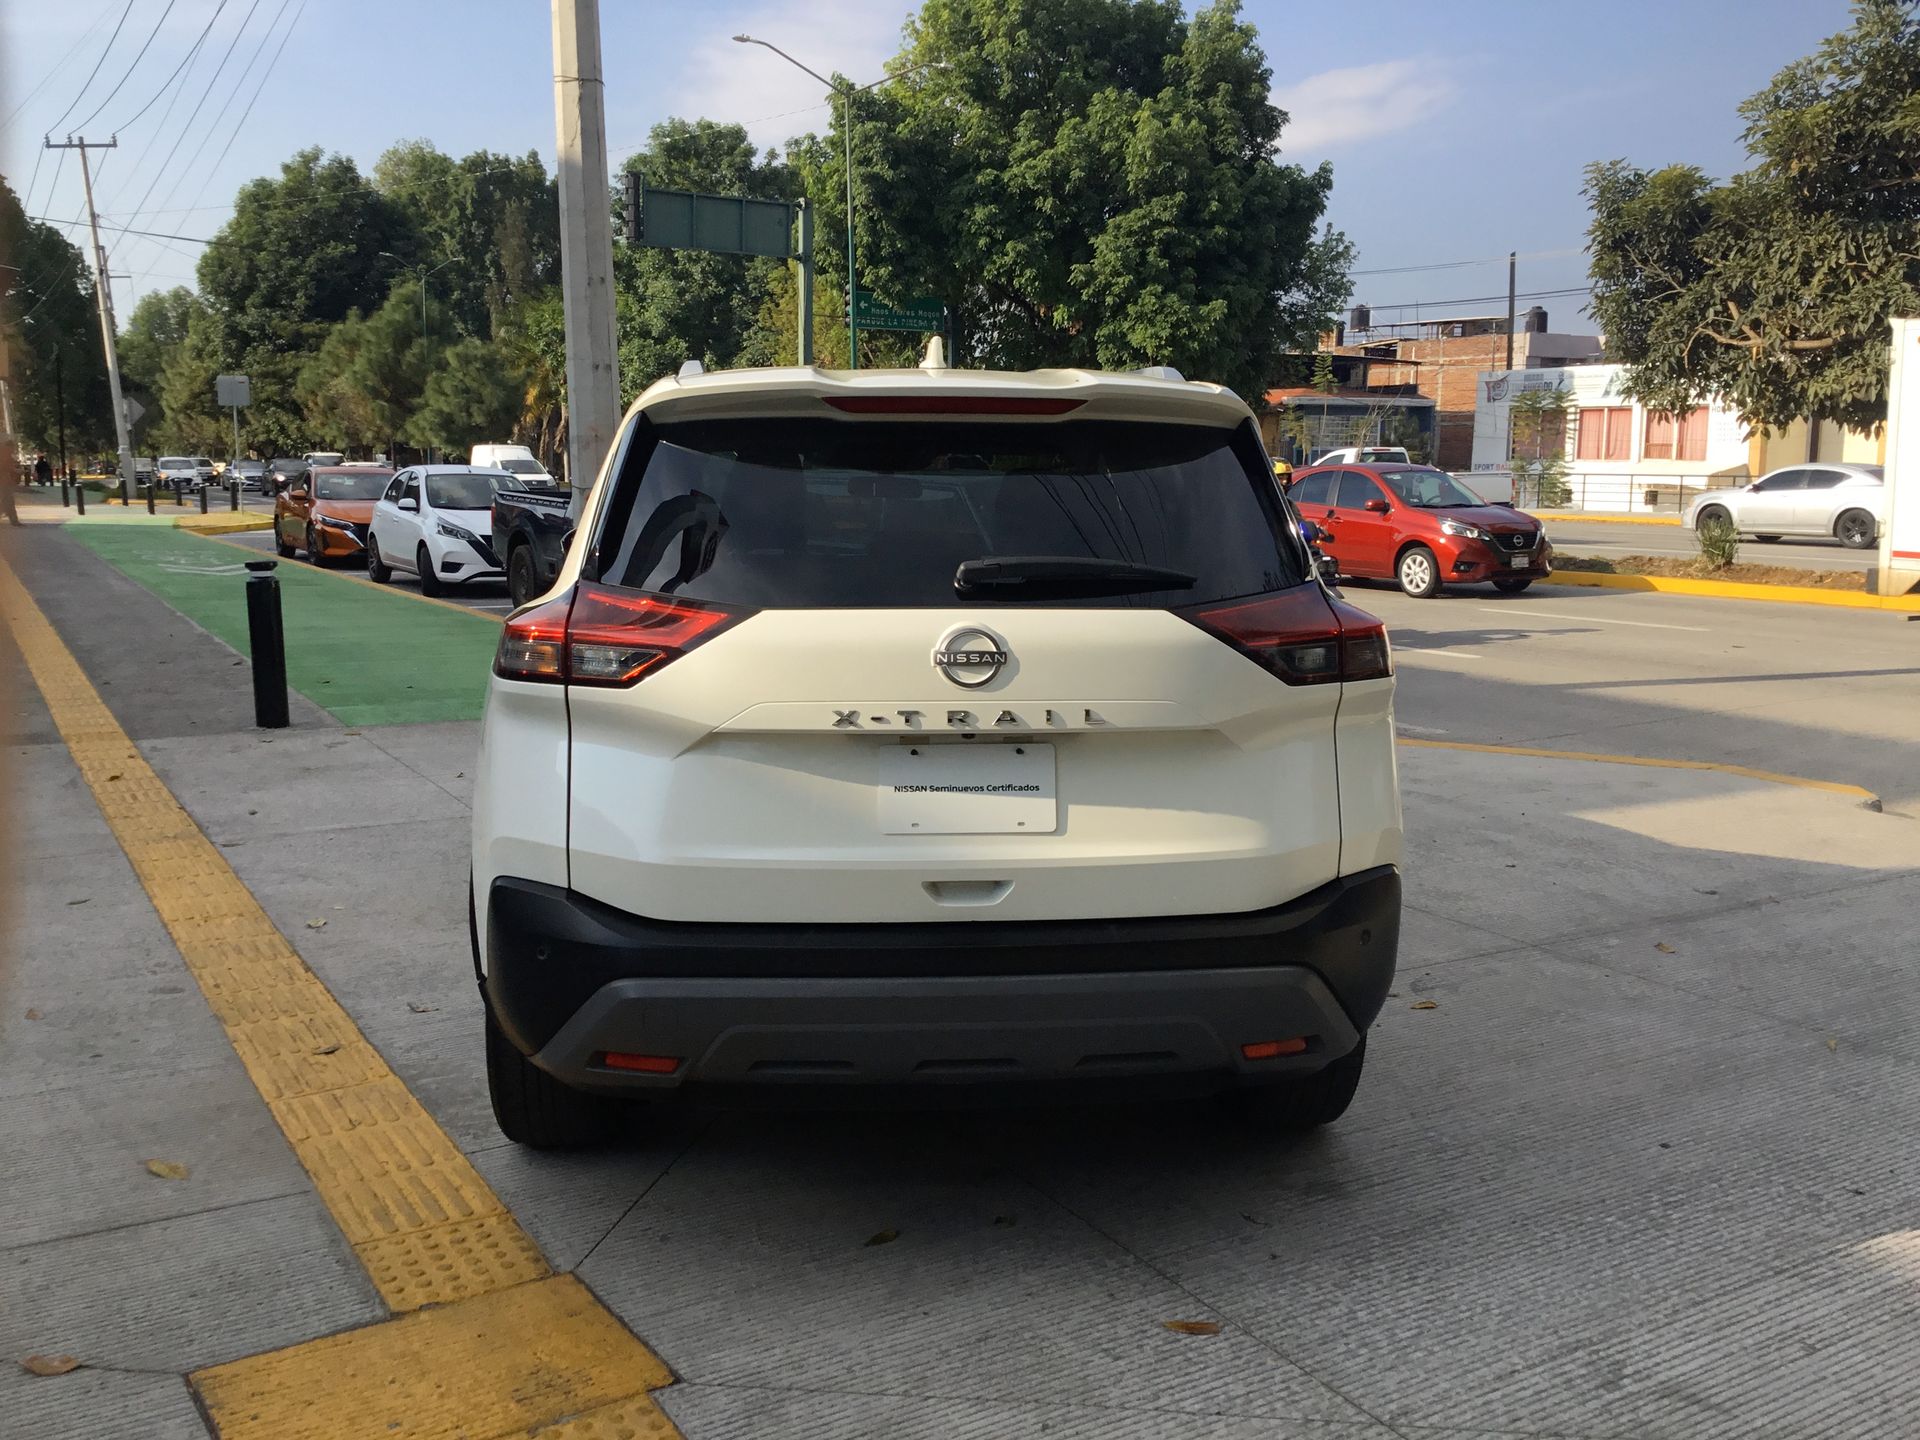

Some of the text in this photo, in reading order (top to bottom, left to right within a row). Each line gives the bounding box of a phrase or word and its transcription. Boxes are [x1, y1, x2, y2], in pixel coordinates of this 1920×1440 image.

[936, 653, 1005, 663] NISSAN
[832, 709, 1106, 727] X-TRAIL
[894, 783, 1040, 793] NISSAN Seminuevos Certificados
